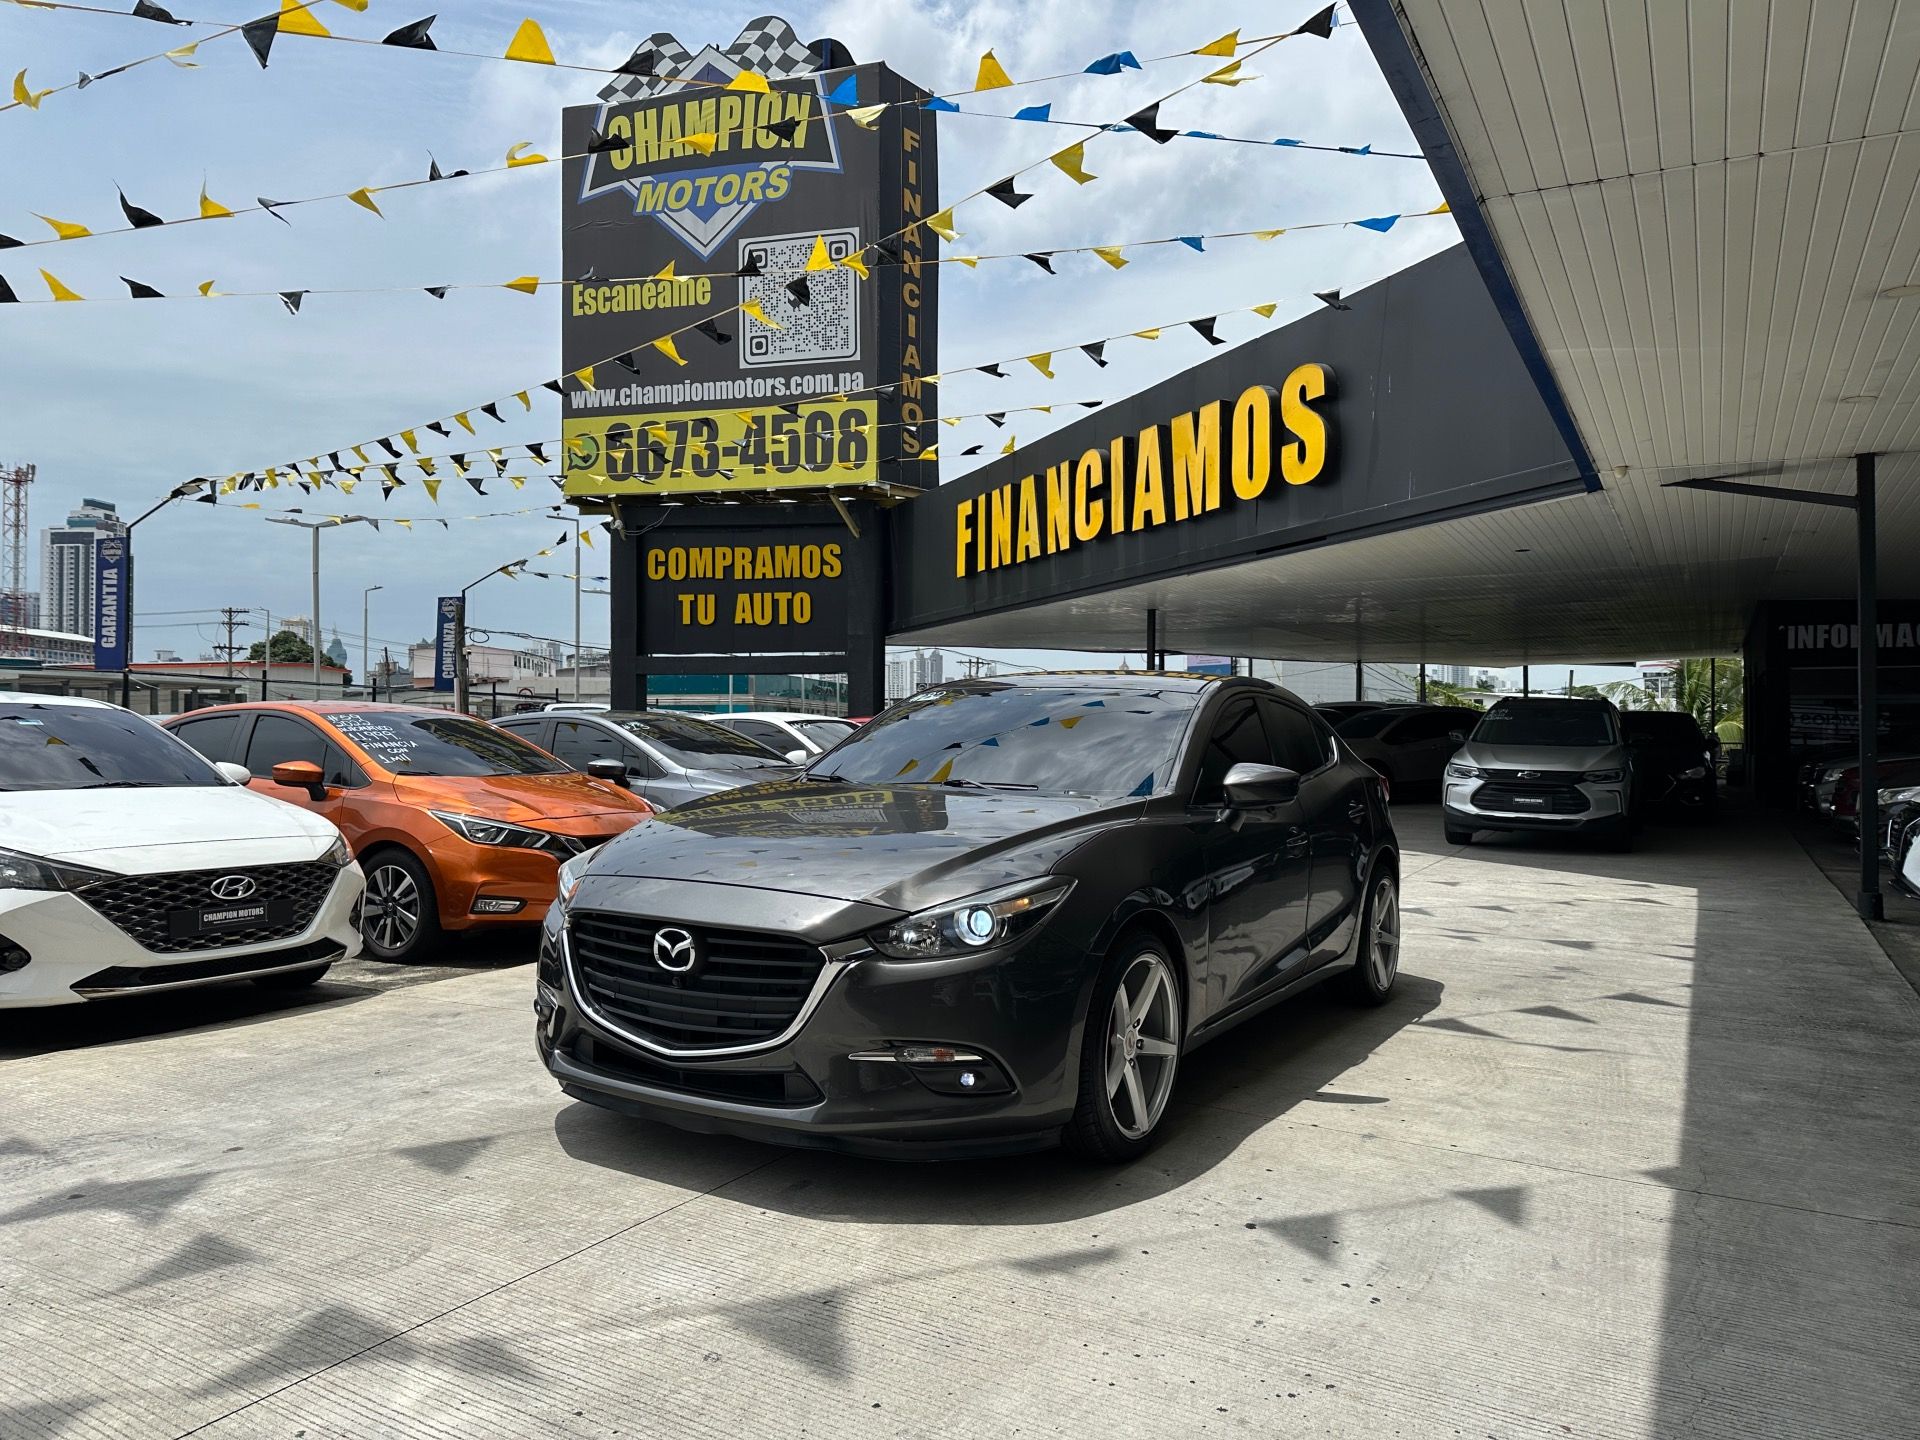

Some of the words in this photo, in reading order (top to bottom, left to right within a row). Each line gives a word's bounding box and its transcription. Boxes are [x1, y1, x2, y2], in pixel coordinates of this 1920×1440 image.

[608, 92, 811, 170] CHAMPION
[636, 168, 790, 213] MOTORS
[902, 128, 923, 453] FINANCIAMOS
[571, 371, 864, 408] www.championmotors.com.pa
[606, 408, 868, 482] 6673-4508
[956, 362, 1331, 578] FINANCIAMOS
[647, 543, 842, 580] COMPRAMOS
[101, 568, 118, 648] GARANTIA
[678, 594, 715, 625] TU
[734, 592, 811, 625] AUTO
[1786, 623, 1920, 649] INFOMA
[203, 910, 237, 921] CHAMPION
[238, 907, 264, 917] MOTORS
